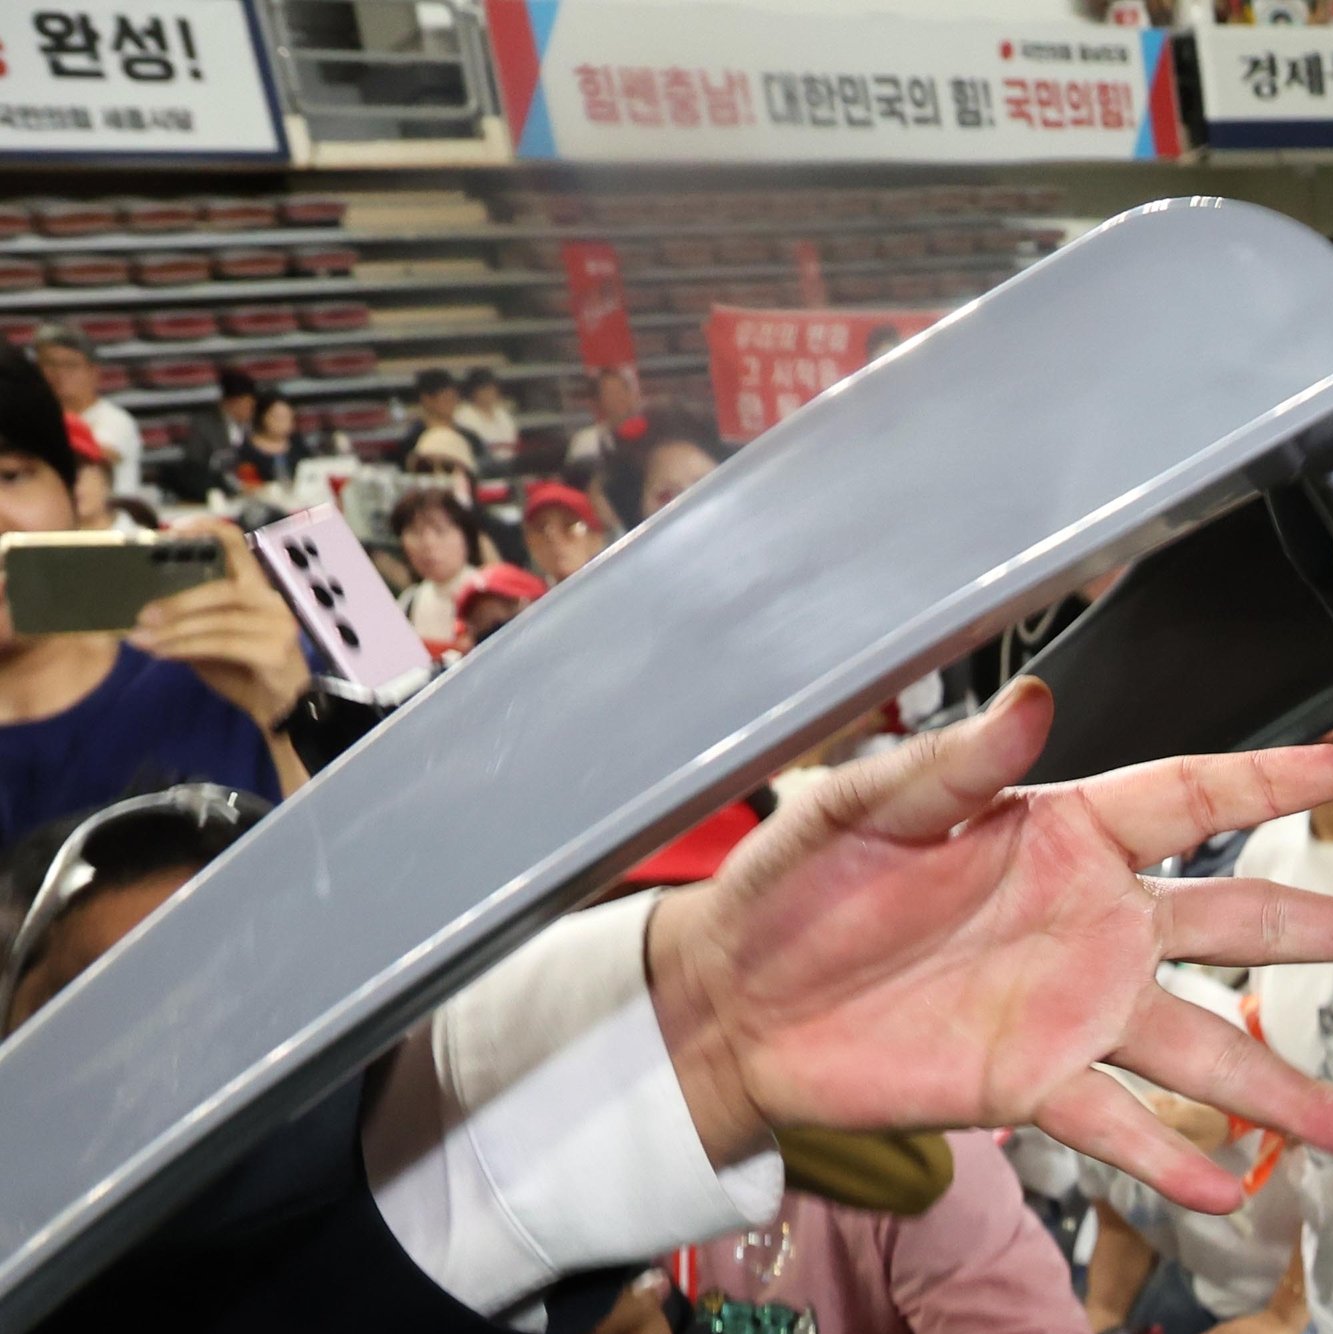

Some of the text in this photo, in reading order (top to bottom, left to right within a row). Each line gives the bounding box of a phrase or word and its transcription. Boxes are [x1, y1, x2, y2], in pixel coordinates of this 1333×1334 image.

[33, 11, 204, 81] 완성!
[761, 71, 943, 128] 대한민국의
[951, 78, 995, 128] 힘!
[1002, 77, 1136, 128] 국민의힘!
